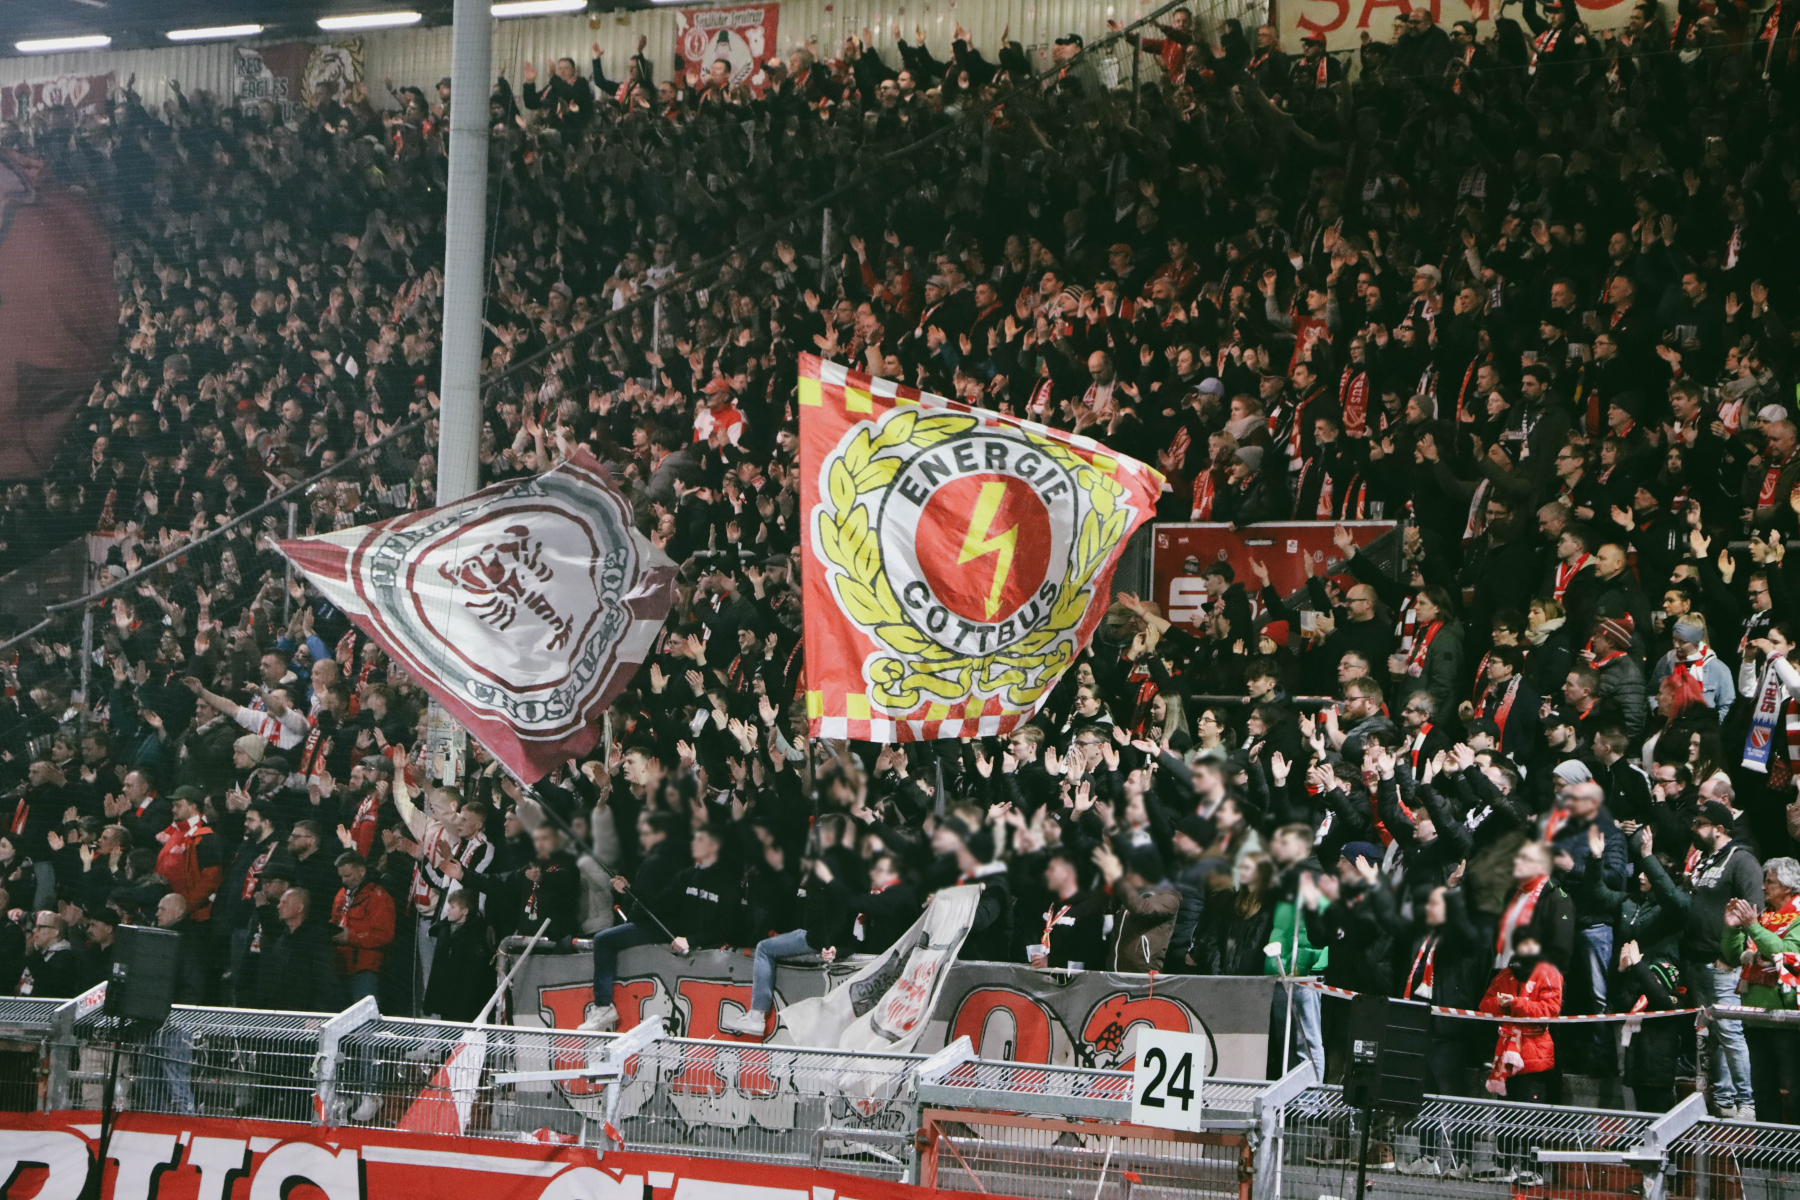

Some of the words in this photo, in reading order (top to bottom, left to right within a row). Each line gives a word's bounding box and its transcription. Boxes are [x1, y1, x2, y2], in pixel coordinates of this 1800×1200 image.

[237, 57, 262, 76] RED
[241, 77, 289, 99] EAGLES
[897, 441, 1069, 508] ENERGIE
[903, 579, 1058, 653] COTTBUS
[1140, 1047, 1195, 1112] 24
